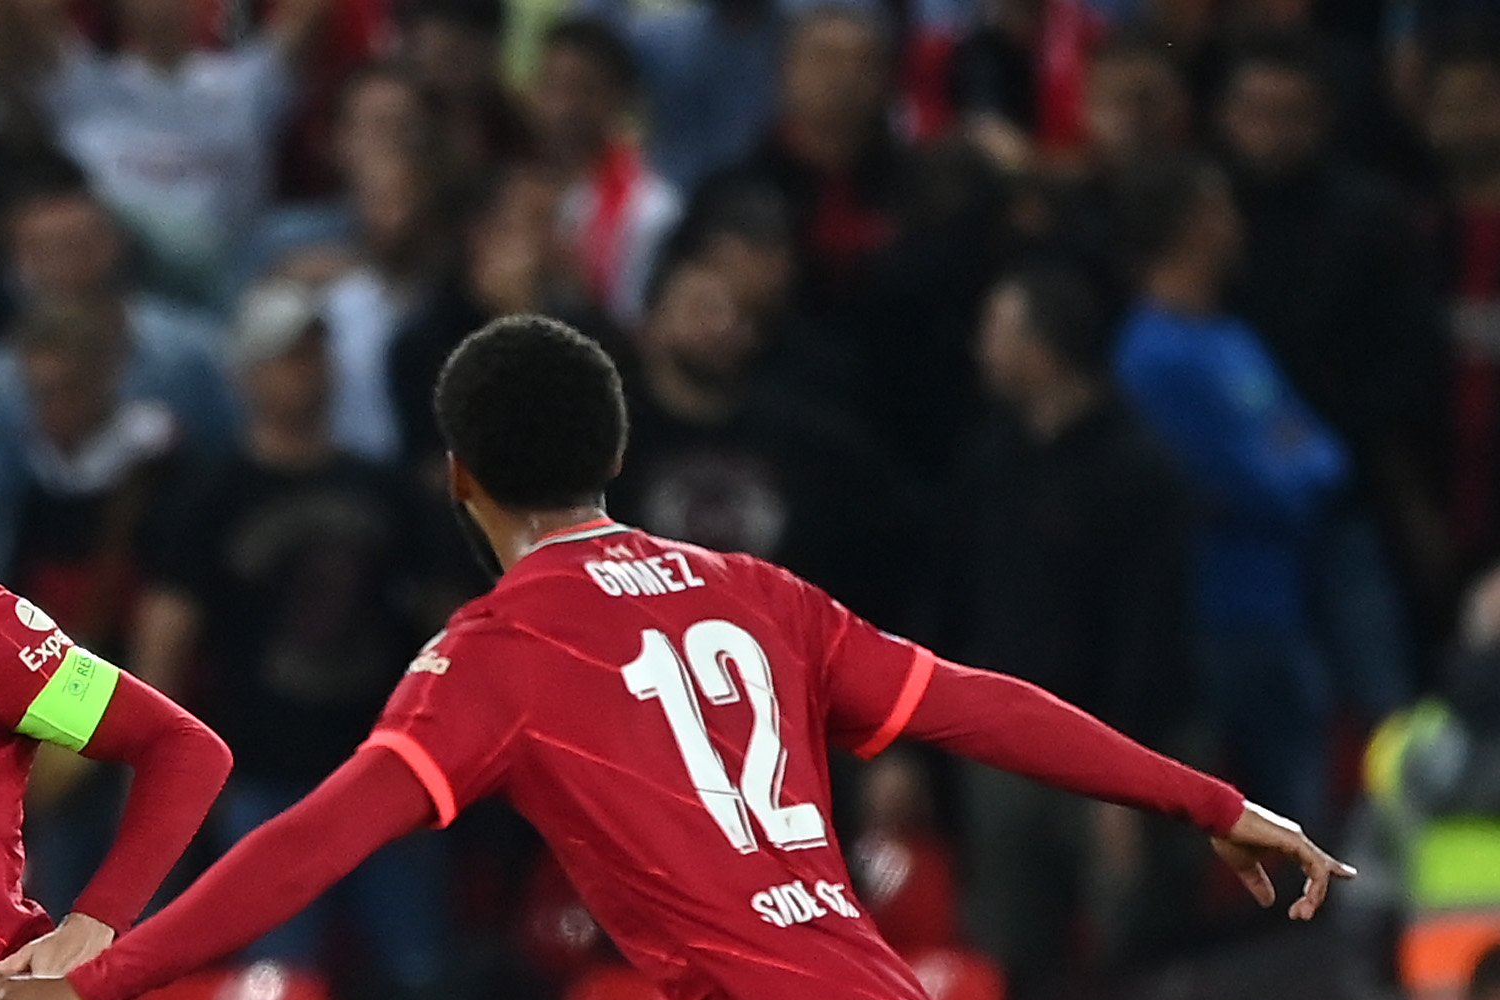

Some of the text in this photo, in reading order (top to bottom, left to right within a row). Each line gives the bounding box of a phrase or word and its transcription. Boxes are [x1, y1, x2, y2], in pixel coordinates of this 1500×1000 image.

[584, 551, 706, 597] GOMEZ
[18, 629, 75, 672] Exp
[620, 619, 829, 855] 12
[750, 880, 828, 928] SIDE
